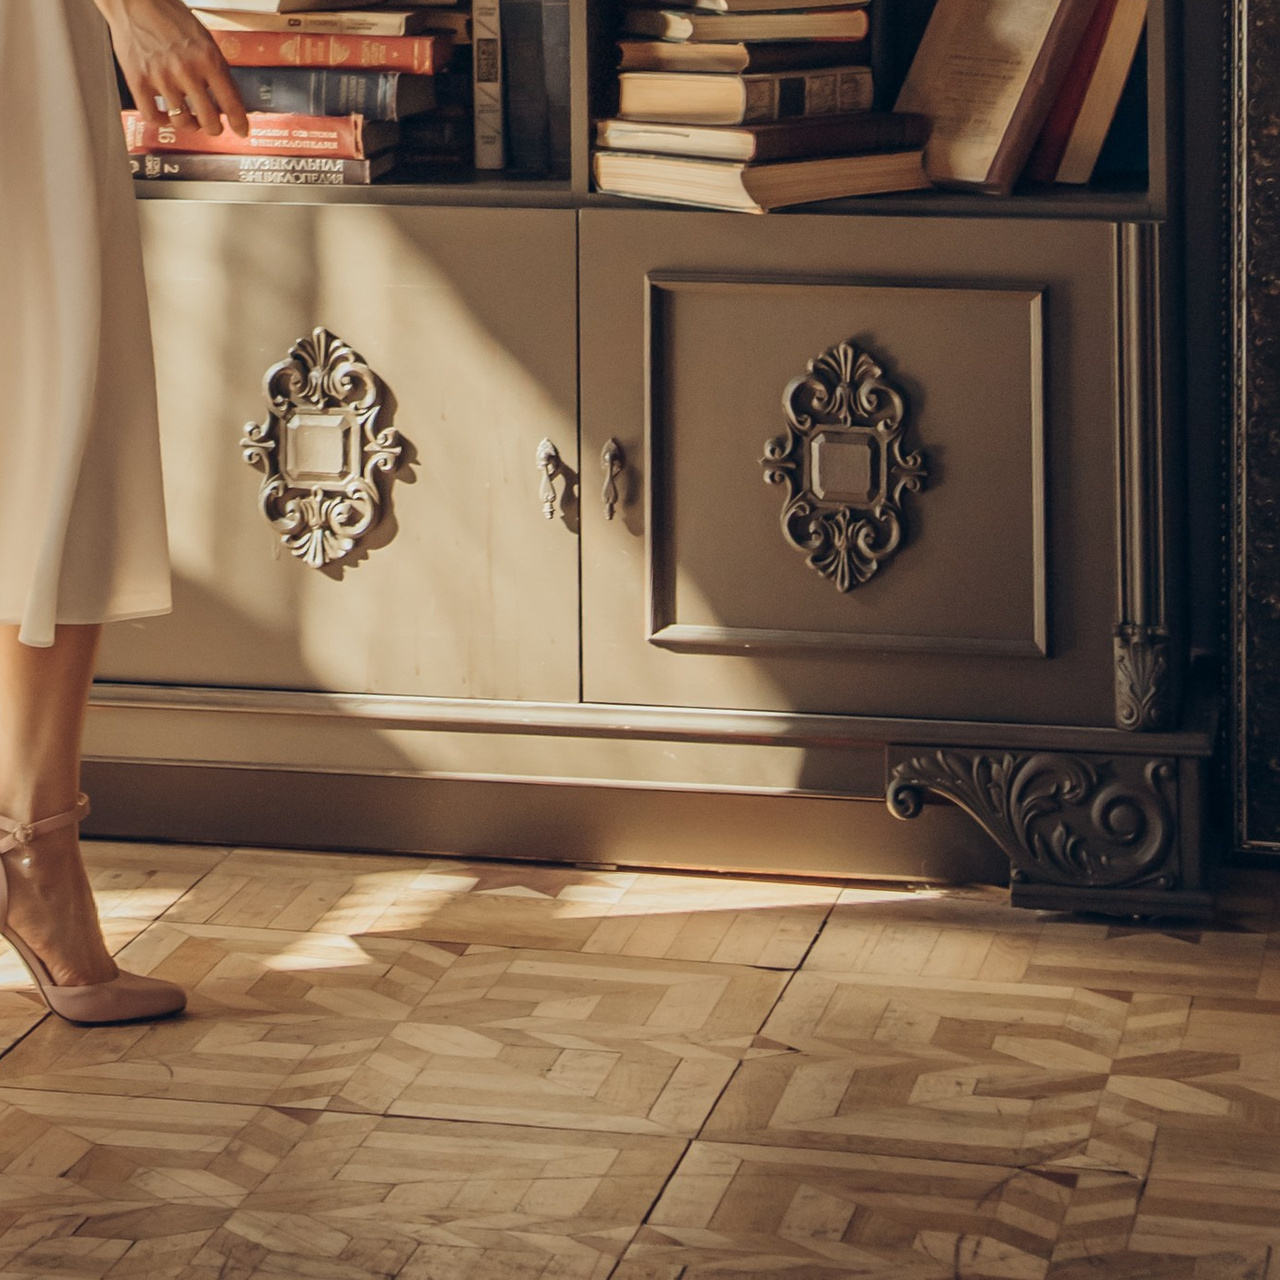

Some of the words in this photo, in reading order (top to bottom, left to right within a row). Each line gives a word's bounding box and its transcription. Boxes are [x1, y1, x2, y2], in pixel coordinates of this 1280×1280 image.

[158, 126, 176, 144] 16
[163, 163, 180, 174] 2
[239, 158, 344, 172] МУЗЫКАЛЬНАЯ
[239, 171, 344, 185] ЭНЦИКЛОПЕДИЯ
